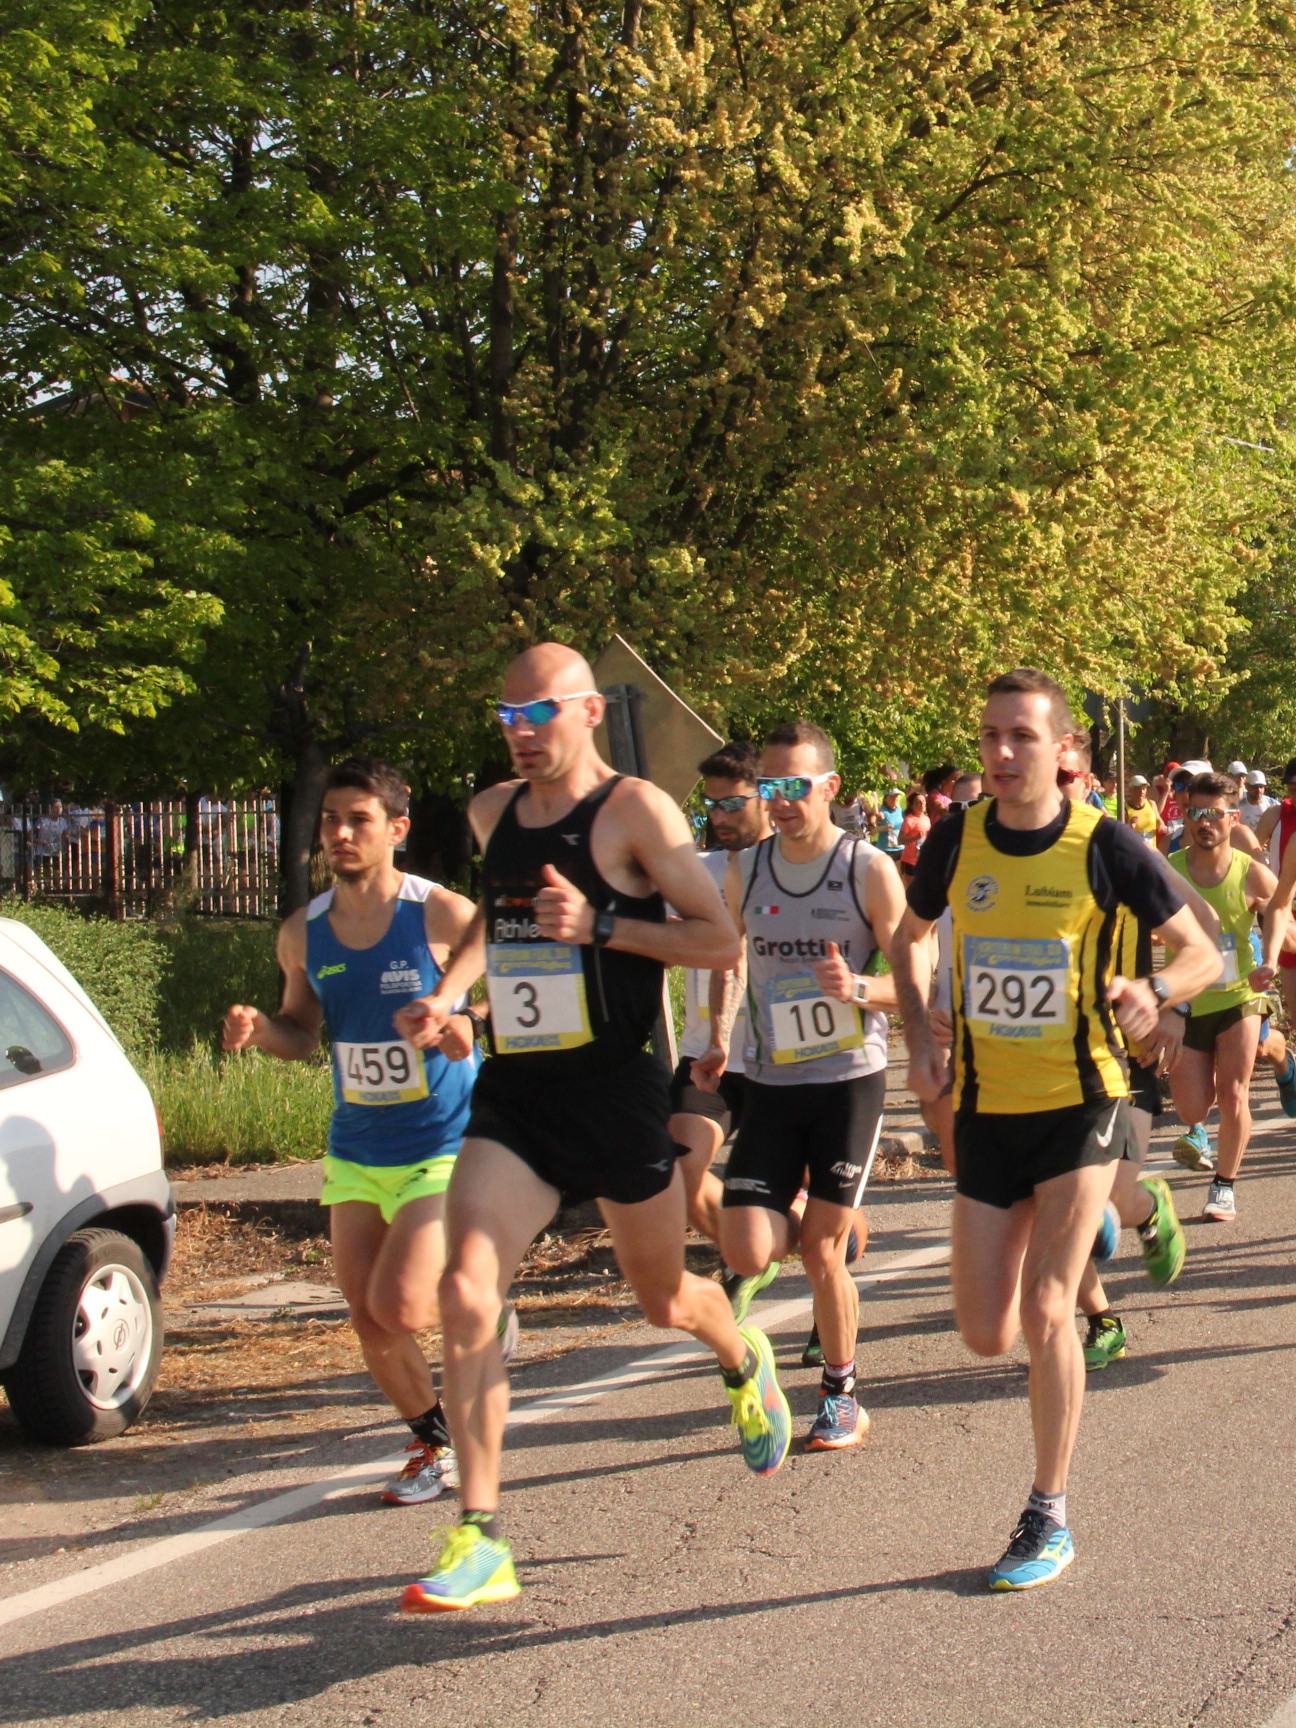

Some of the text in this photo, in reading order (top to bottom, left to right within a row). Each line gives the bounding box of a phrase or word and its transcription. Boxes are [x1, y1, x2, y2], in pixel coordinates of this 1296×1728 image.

[494, 918, 541, 938] Athle
[381, 969, 420, 984] AVIS
[389, 960, 410, 970] G.P.
[513, 981, 541, 1028] 3
[976, 972, 1057, 1019] 292
[790, 1001, 835, 1042] 10
[347, 1045, 411, 1086] 459
